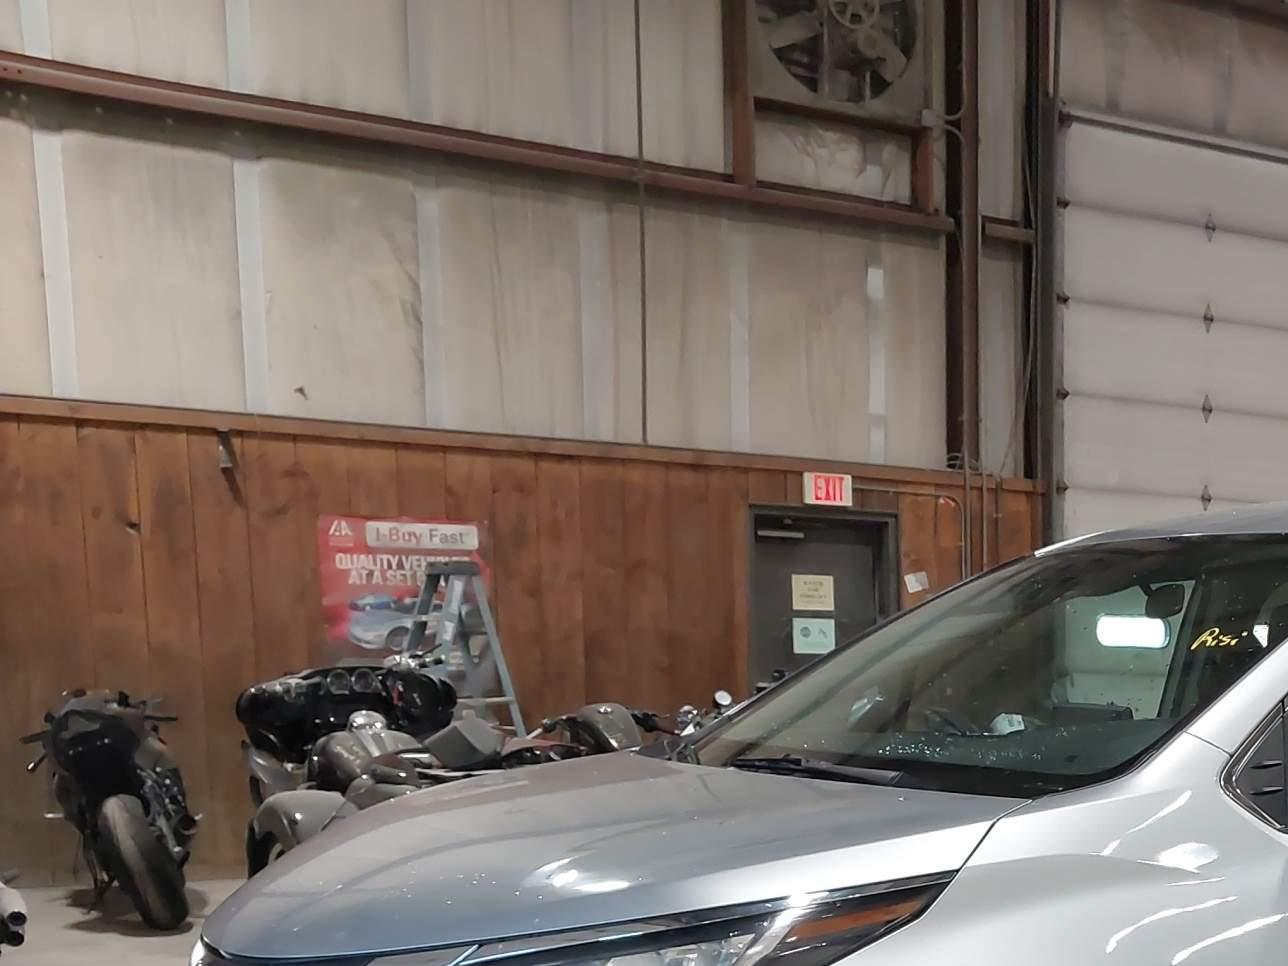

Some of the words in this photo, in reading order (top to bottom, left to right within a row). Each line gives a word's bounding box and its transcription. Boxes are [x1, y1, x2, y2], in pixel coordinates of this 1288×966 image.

[814, 475, 845, 502] EXIT
[375, 526, 422, 545] I-Buy
[429, 528, 465, 545] Fast
[335, 553, 400, 570] QUALITY
[348, 569, 370, 585] AT
[371, 569, 384, 585] A
[386, 570, 412, 586] SET
